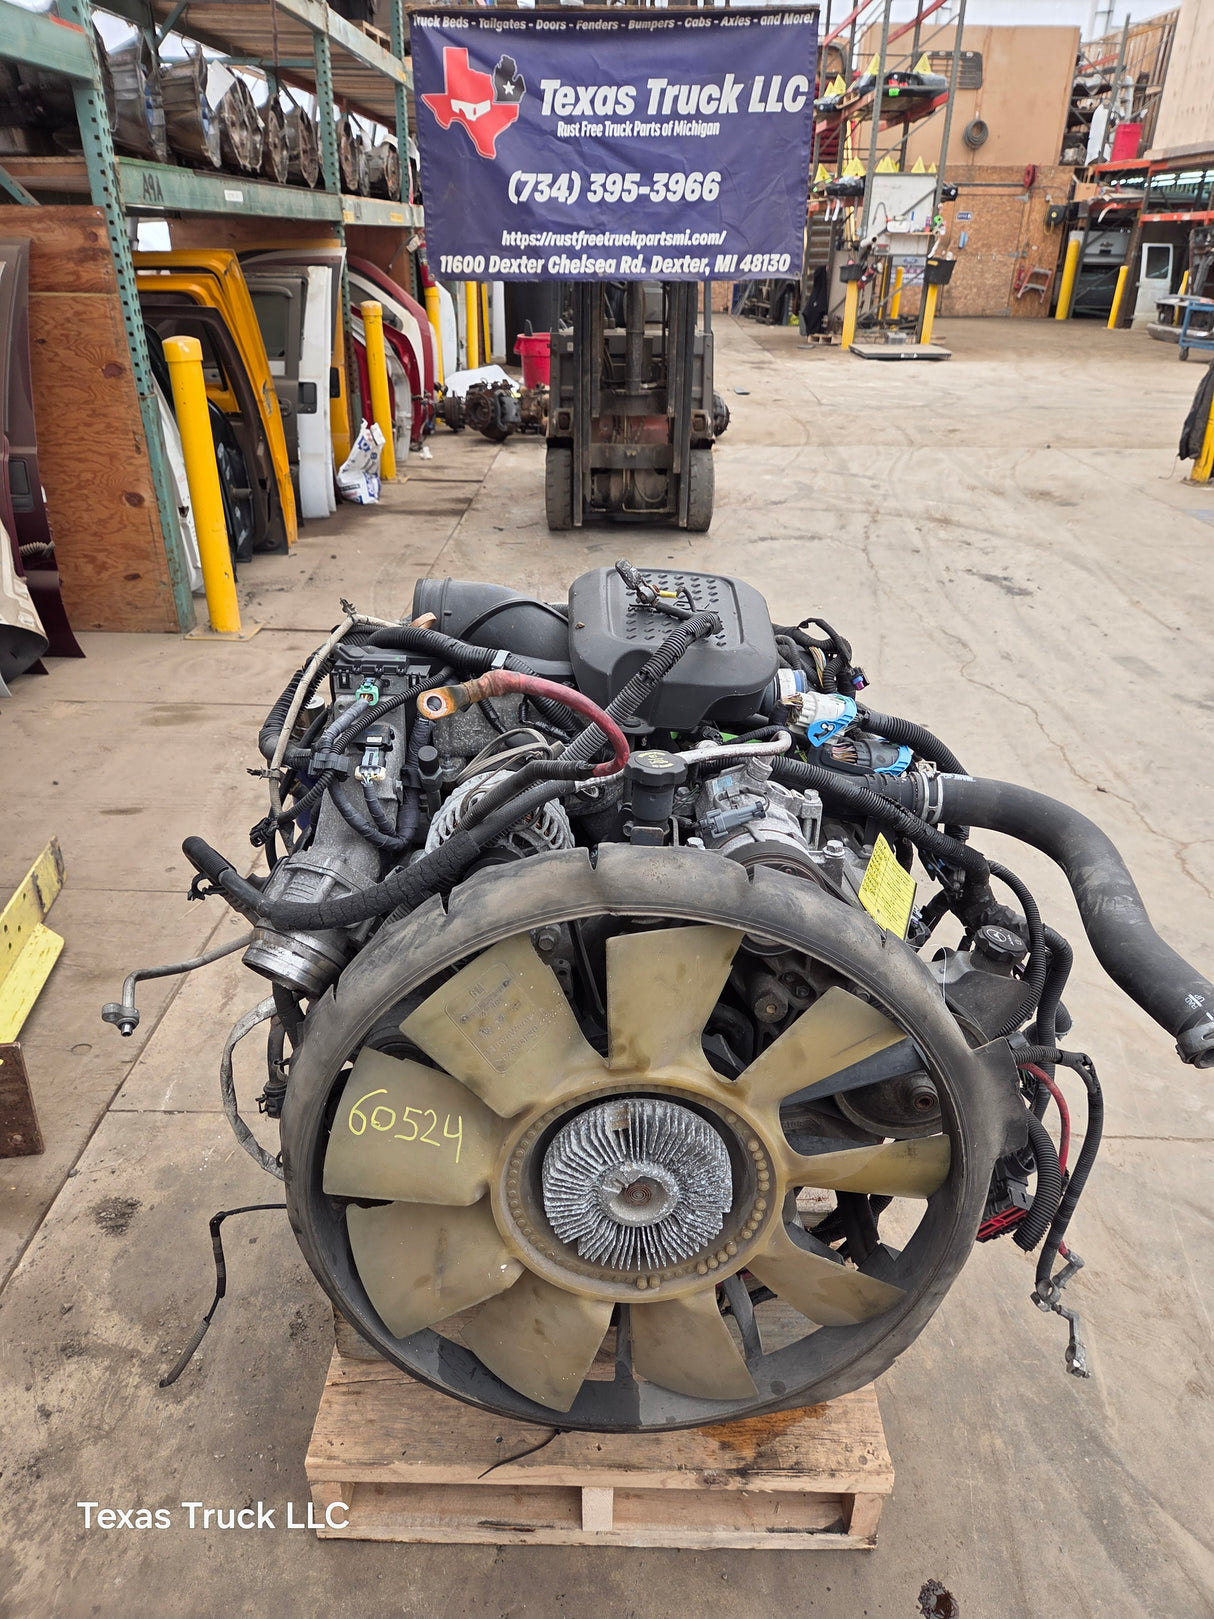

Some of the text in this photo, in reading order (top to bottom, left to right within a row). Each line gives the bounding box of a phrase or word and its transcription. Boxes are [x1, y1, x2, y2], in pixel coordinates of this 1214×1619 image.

[442, 16, 469, 28] Beds
[479, 17, 526, 32] Tailgates
[535, 19, 567, 30] Doors
[576, 19, 619, 31] Fenders
[628, 19, 675, 31] Bumpers
[684, 17, 711, 28] Cabs
[760, 13, 780, 25] and
[783, 12, 815, 25] More!
[540, 73, 809, 116] Texas Truck LLC
[557, 120, 720, 138] Rust Free Truck Parts of Michigan
[508, 170, 722, 205] (734) 395-3966
[501, 228, 727, 250] https://rustfreetruckpartsmi.com/
[440, 253, 791, 276] 11600 Dexter Chelsea Rd. Dexter, MI 48130
[348, 1088, 463, 1163] 60524
